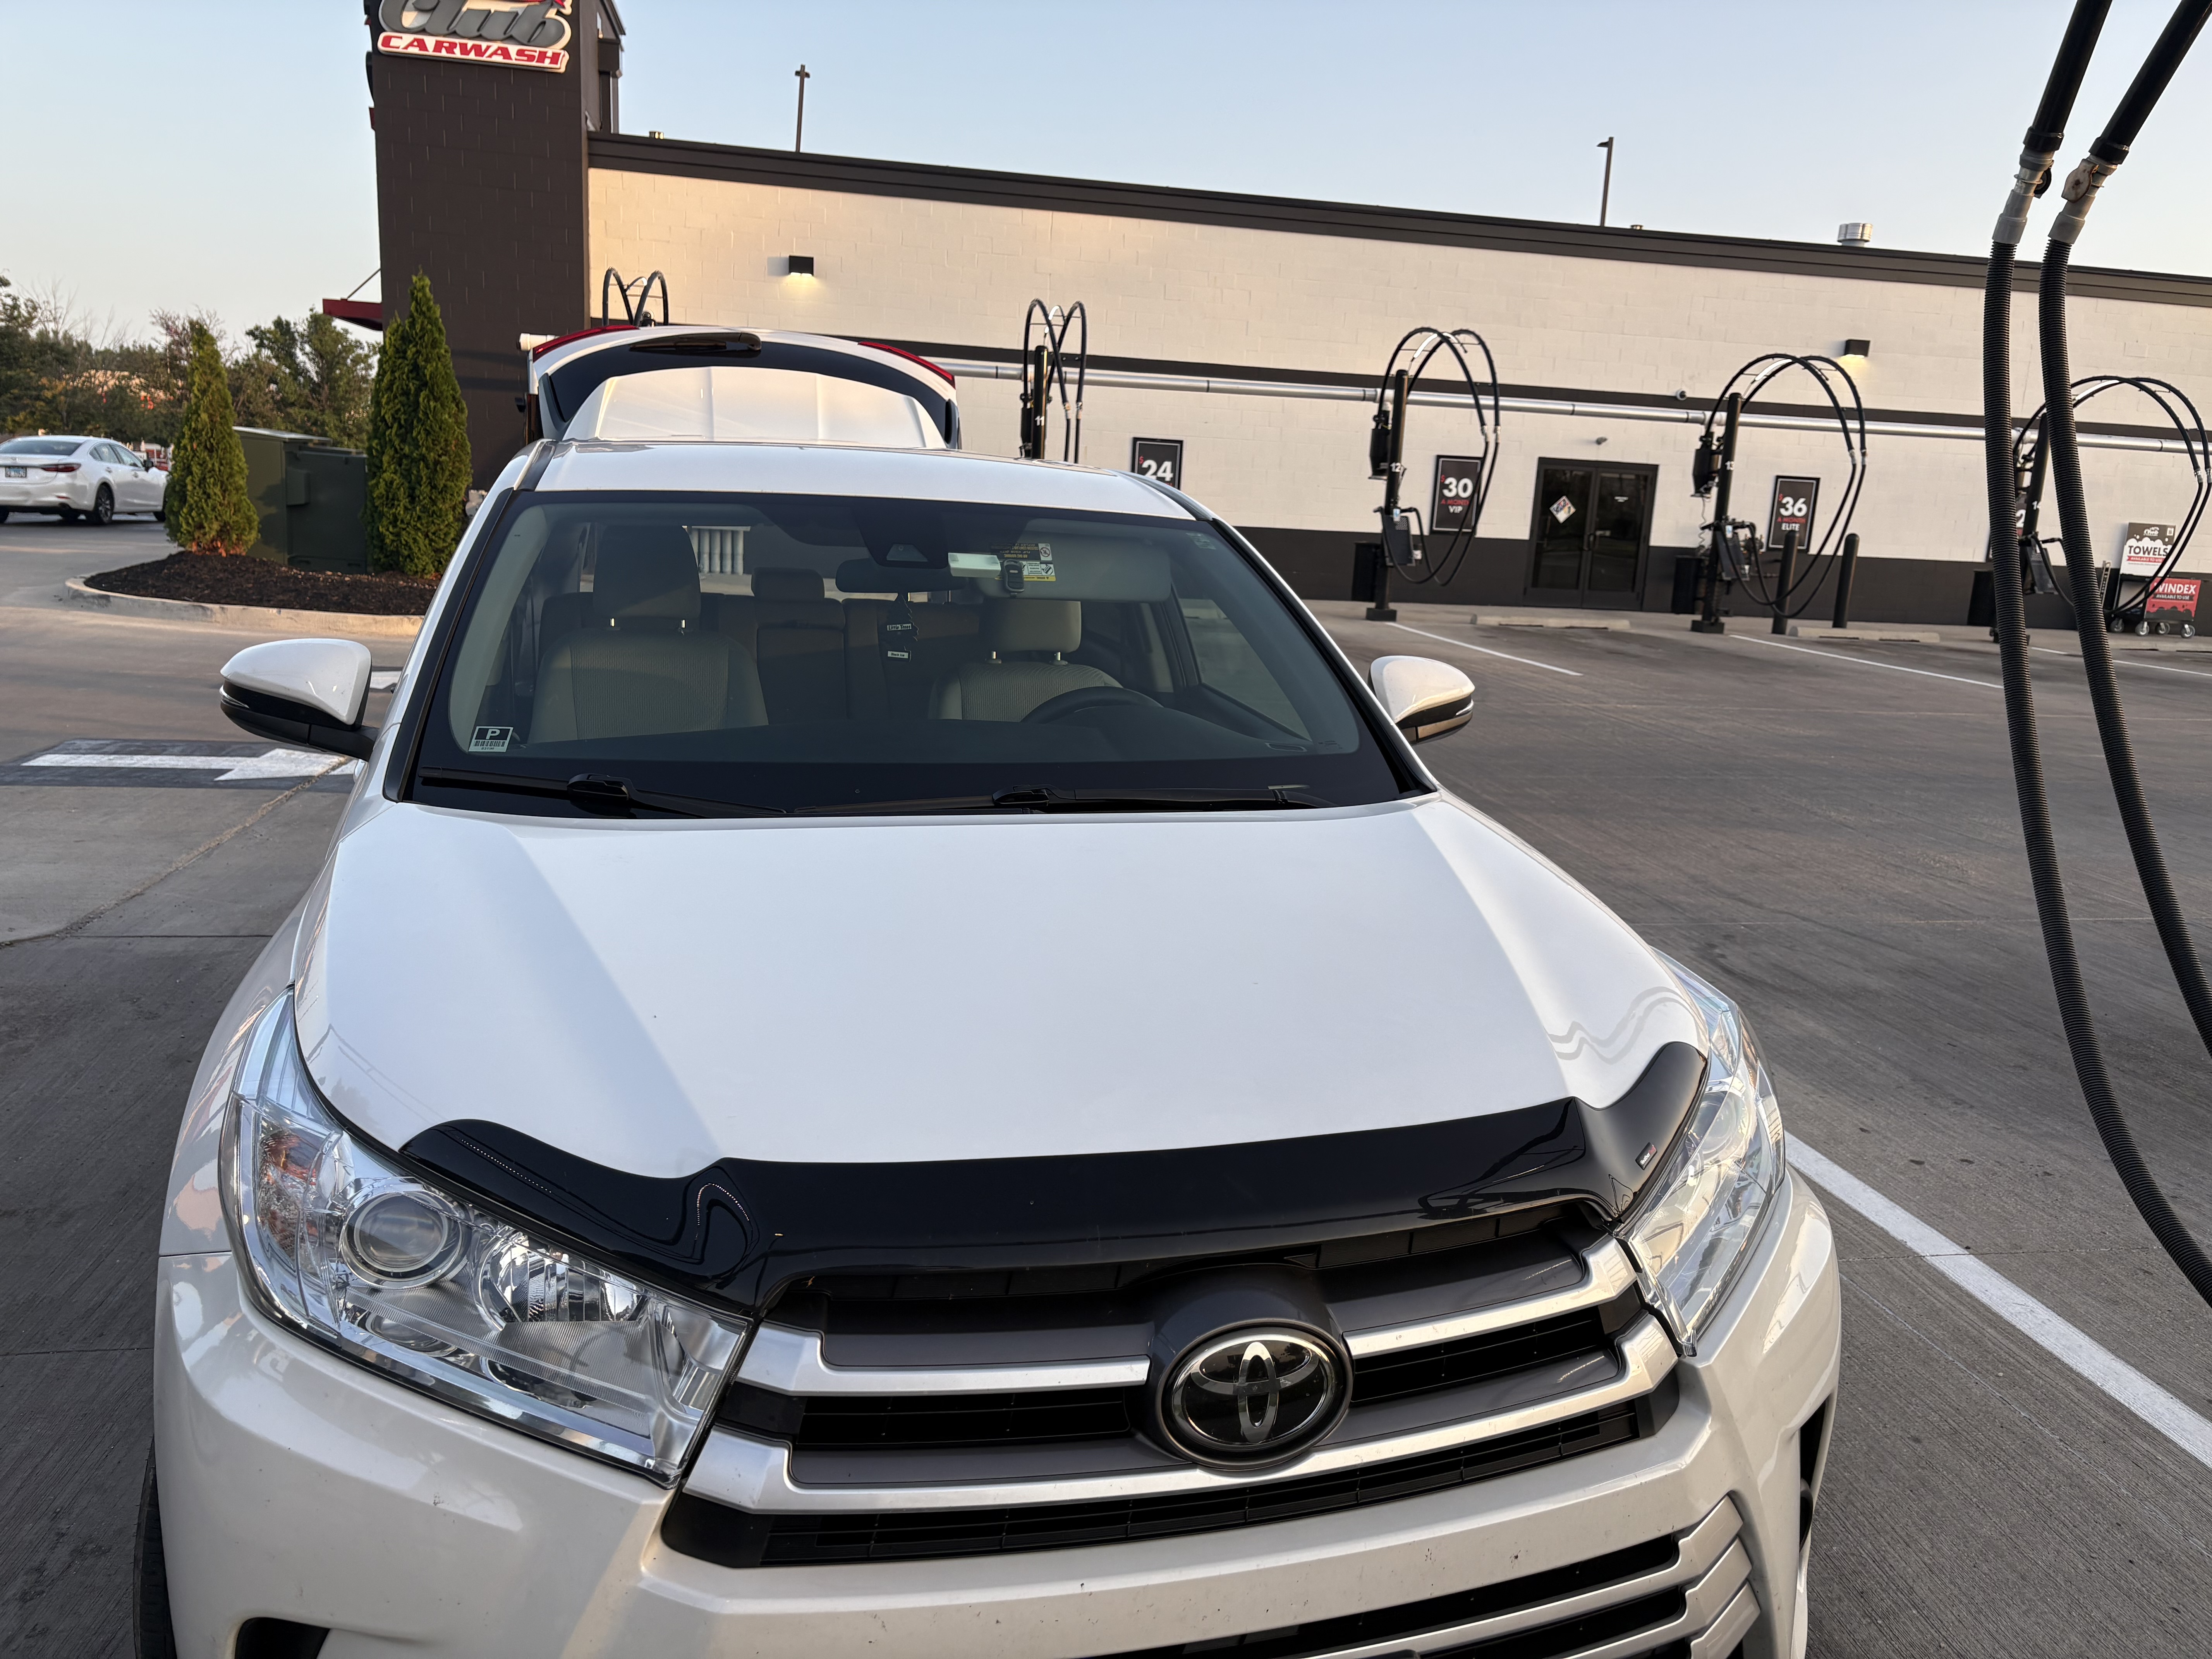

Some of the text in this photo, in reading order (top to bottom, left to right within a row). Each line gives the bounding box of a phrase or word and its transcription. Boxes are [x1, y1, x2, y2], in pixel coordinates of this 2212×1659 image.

[381, 34, 563, 66] CARWASH
[1034, 415, 1045, 426] 11
[1390, 462, 1401, 472] 12
[1448, 505, 1463, 514] VIP
[1781, 523, 1800, 531] ELITE
[2128, 545, 2169, 556] TOWELS
[2154, 582, 2197, 594] WINDEX
[486, 728, 500, 740] P
